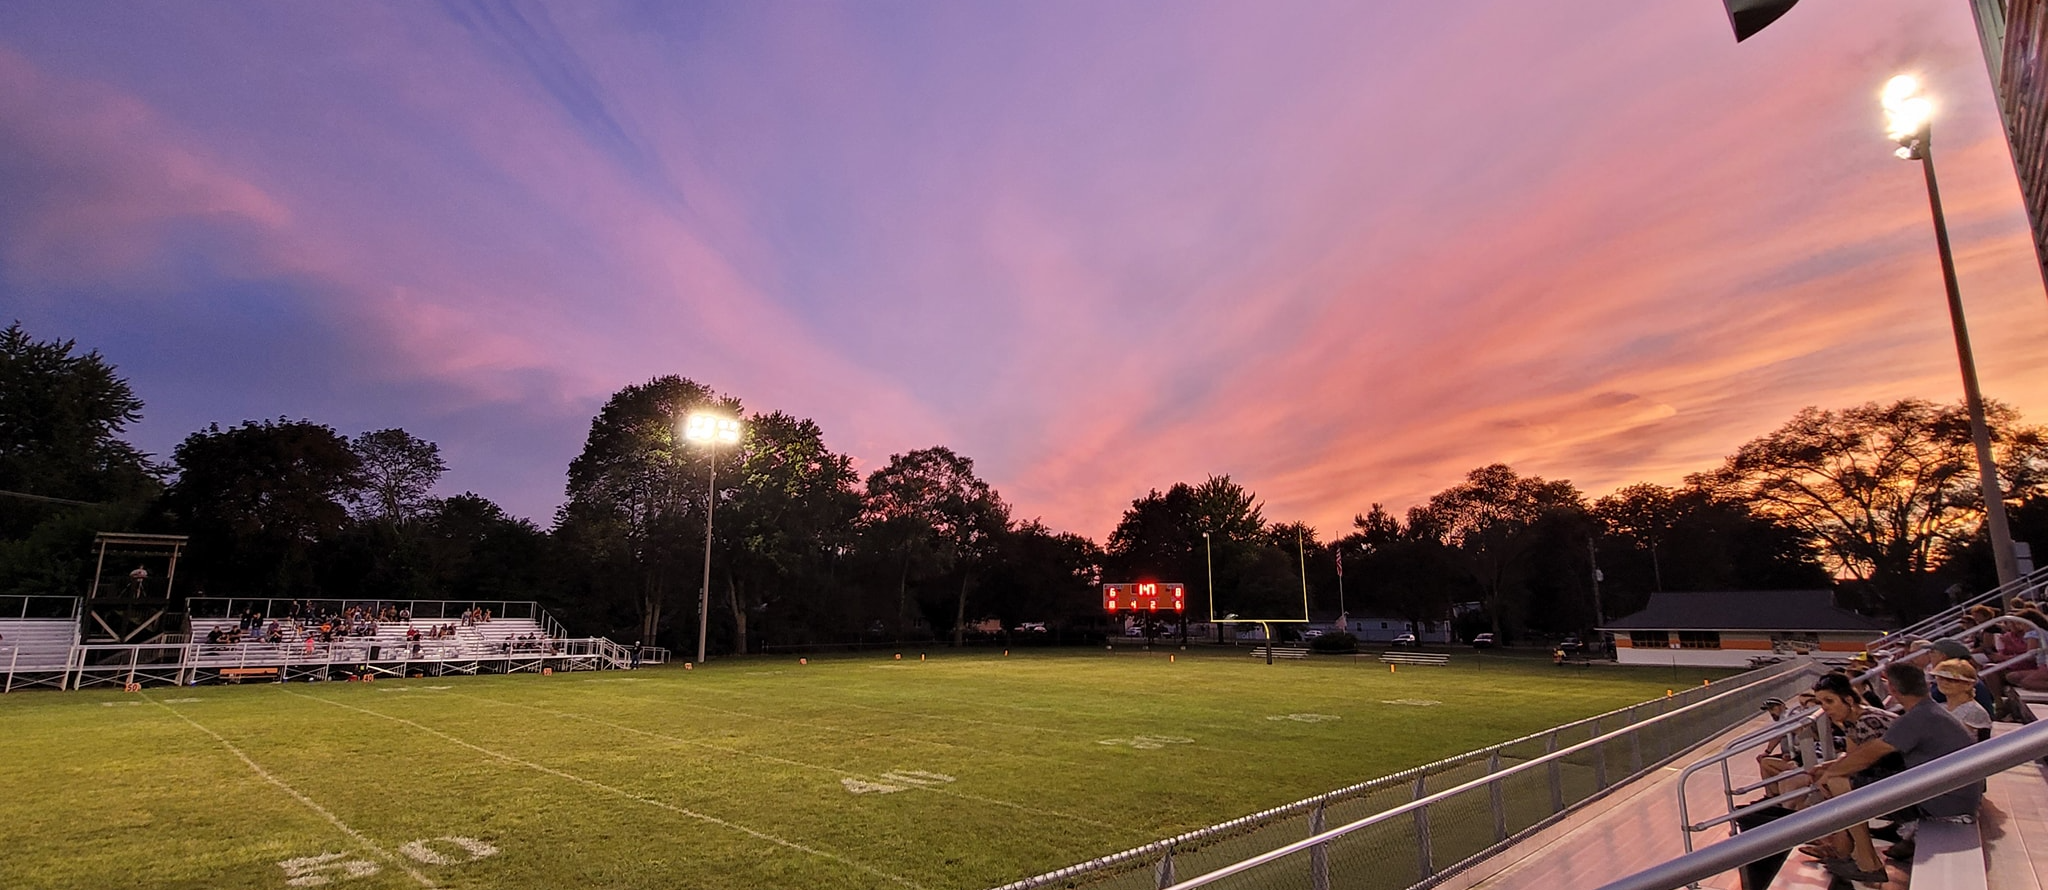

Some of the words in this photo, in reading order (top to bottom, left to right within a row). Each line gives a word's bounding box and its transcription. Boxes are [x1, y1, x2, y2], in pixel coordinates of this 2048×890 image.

[1109, 587, 1116, 597] 6
[1130, 600, 1137, 609] 4
[1150, 600, 1156, 609] 2
[277, 836, 500, 887] 50
